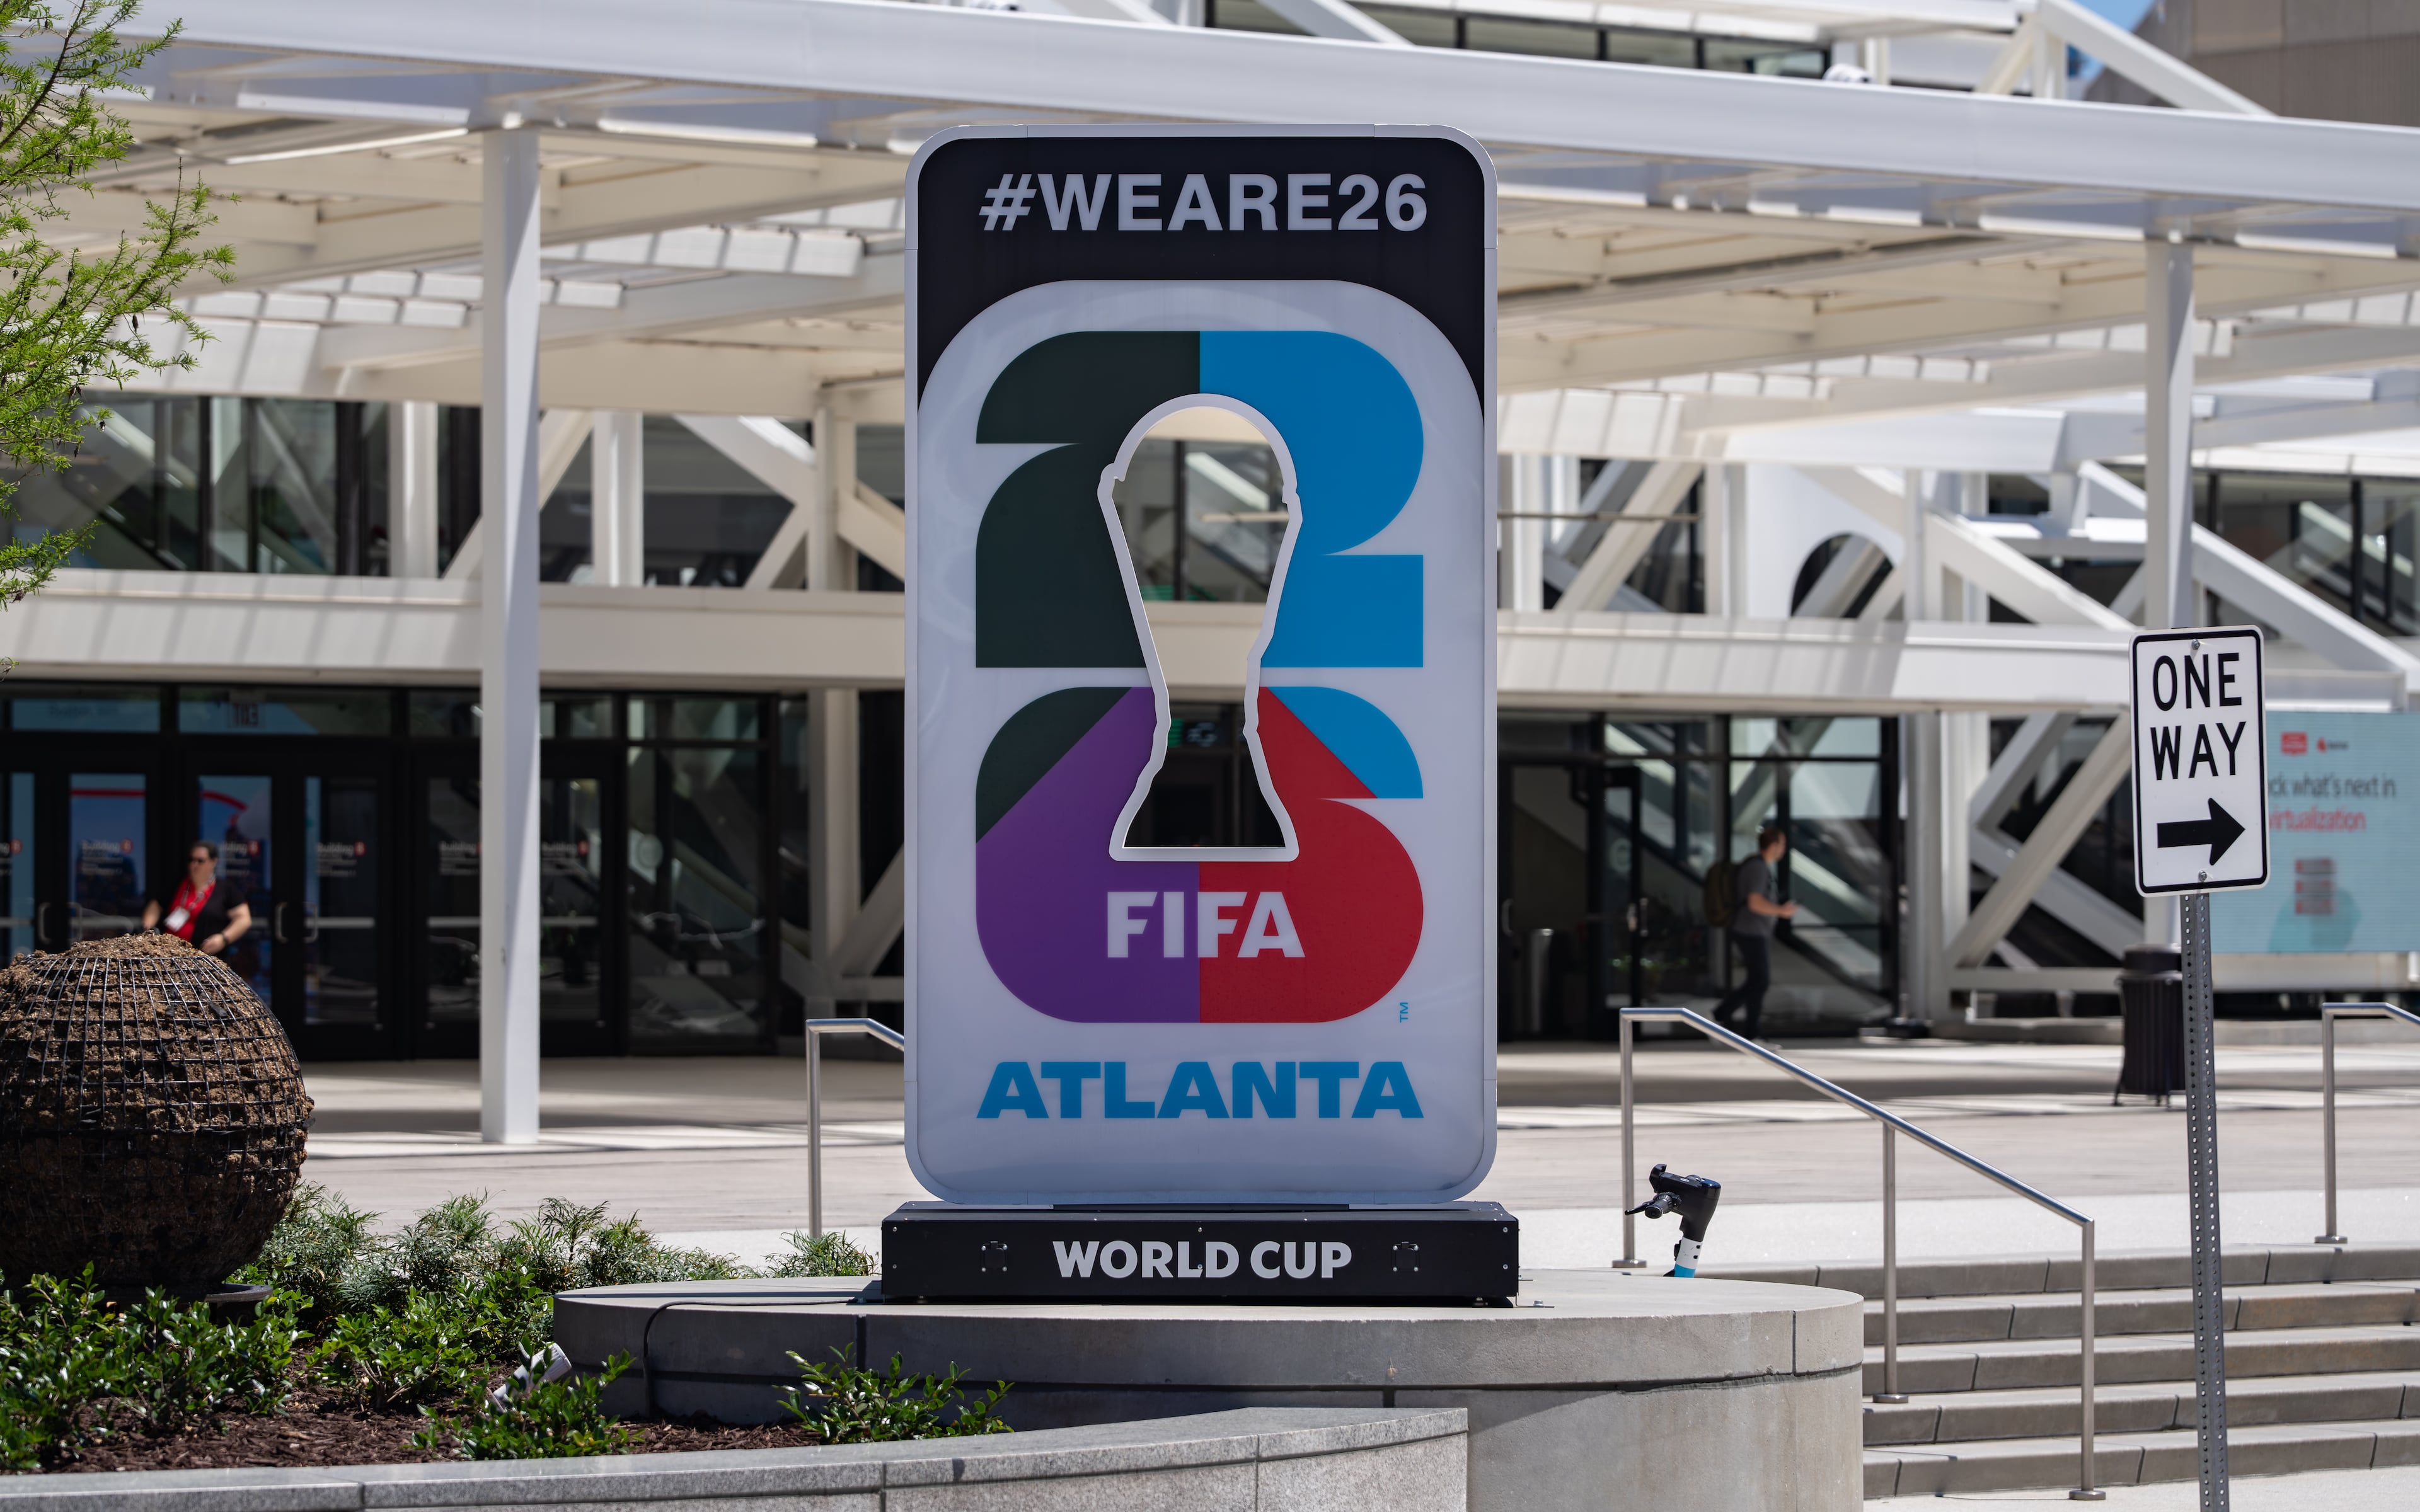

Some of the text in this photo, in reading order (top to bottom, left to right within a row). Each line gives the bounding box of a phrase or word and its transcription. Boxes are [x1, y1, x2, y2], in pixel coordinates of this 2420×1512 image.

[979, 173, 1427, 231] #WEARE26
[2152, 652, 2242, 711] ONE
[2150, 721, 2247, 781] WAY
[2292, 772, 2341, 799] what's
[2344, 775, 2379, 799] next
[2382, 774, 2396, 799] in
[1107, 891, 1305, 958] FIFA
[1399, 1001, 1409, 1023] TM
[976, 1062, 1424, 1119] ATLANTA
[1053, 1240, 1352, 1278] WORLD CUP
